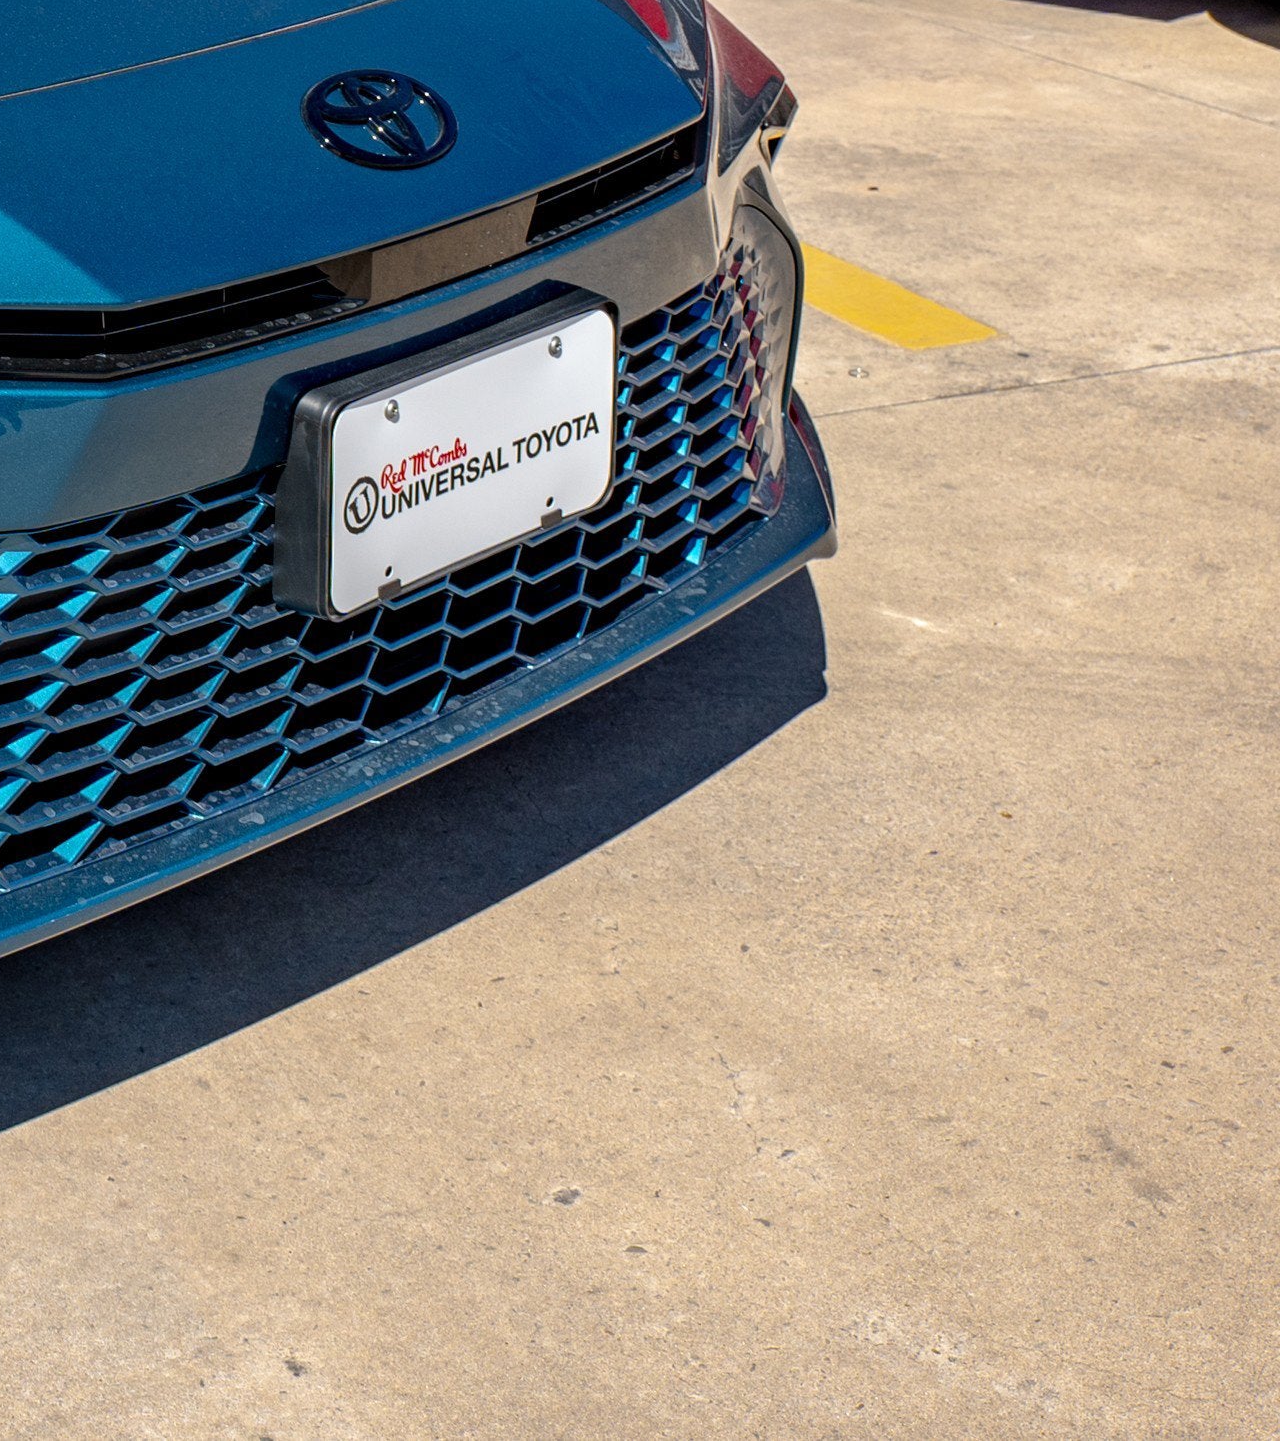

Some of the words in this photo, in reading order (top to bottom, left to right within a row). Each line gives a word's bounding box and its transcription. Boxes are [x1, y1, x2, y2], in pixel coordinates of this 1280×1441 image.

[381, 459, 407, 493] Red
[409, 437, 468, 476] McCombs
[382, 446, 510, 519] UNIVERSAL
[512, 411, 600, 464] TOYOTA
